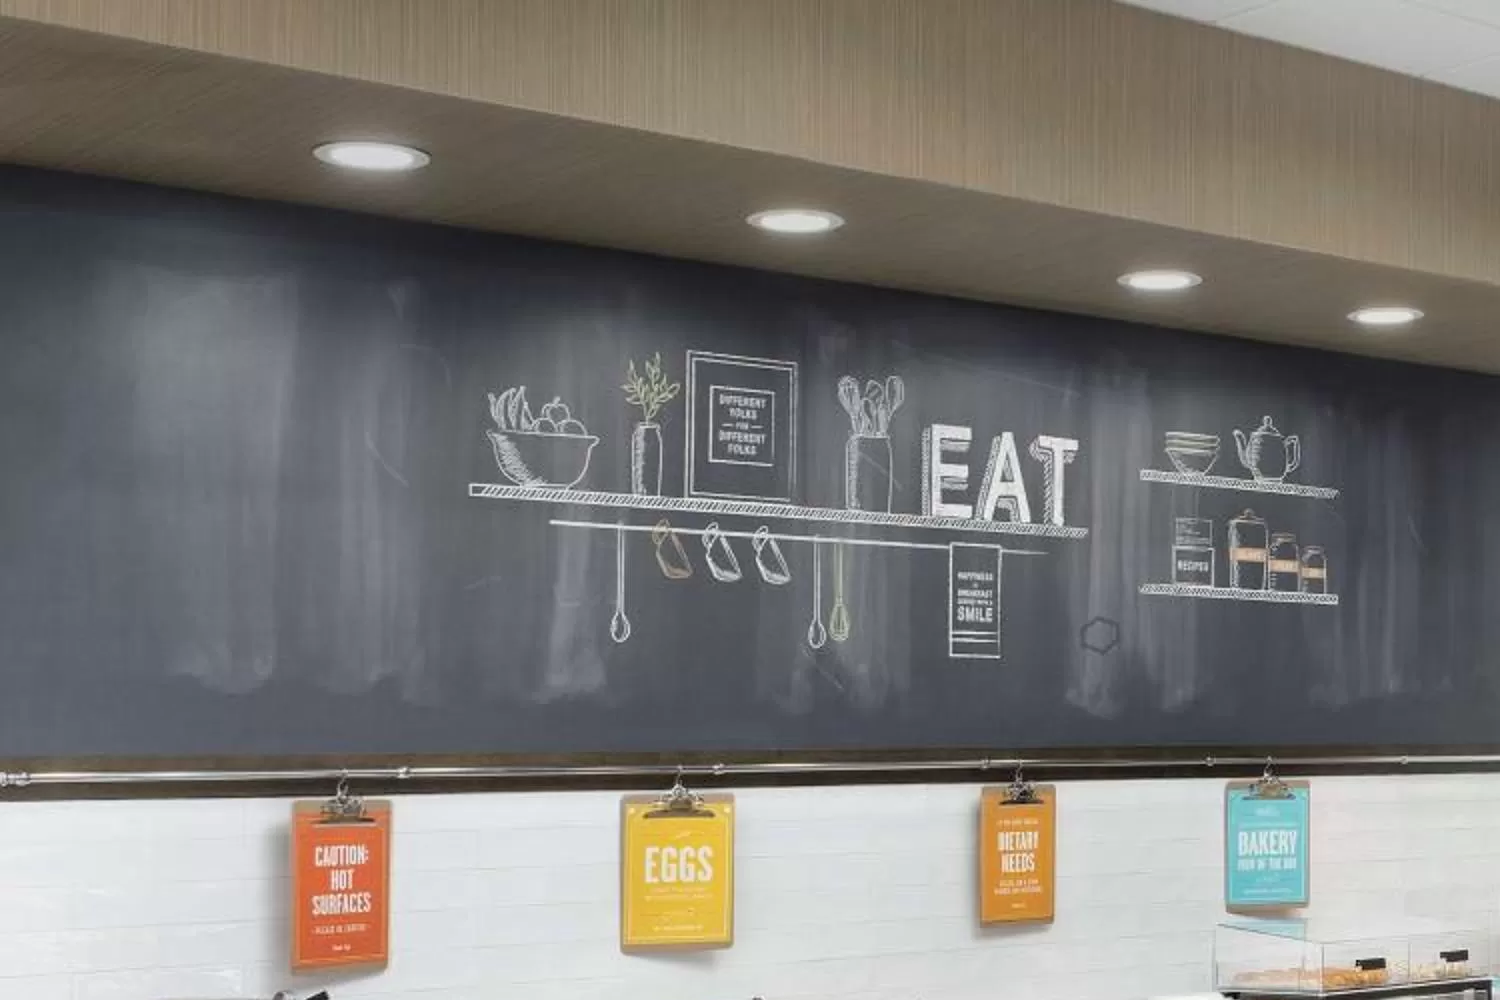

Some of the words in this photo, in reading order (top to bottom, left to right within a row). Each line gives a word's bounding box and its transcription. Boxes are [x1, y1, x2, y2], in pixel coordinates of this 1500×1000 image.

[719, 394, 767, 408] DIFFERENT
[719, 430, 766, 444] DIFFERENT
[728, 443, 757, 455] FOLKS
[922, 423, 1079, 527] EAT
[957, 605, 993, 622] SMILE
[998, 831, 1039, 851] DIETARY
[1239, 831, 1297, 856] BAKERY
[315, 844, 368, 868] CAUTION:
[645, 845, 713, 883] EGGS
[1002, 853, 1036, 873] NEEDS
[331, 869, 354, 890] HOT
[312, 892, 372, 916] SURFACES
